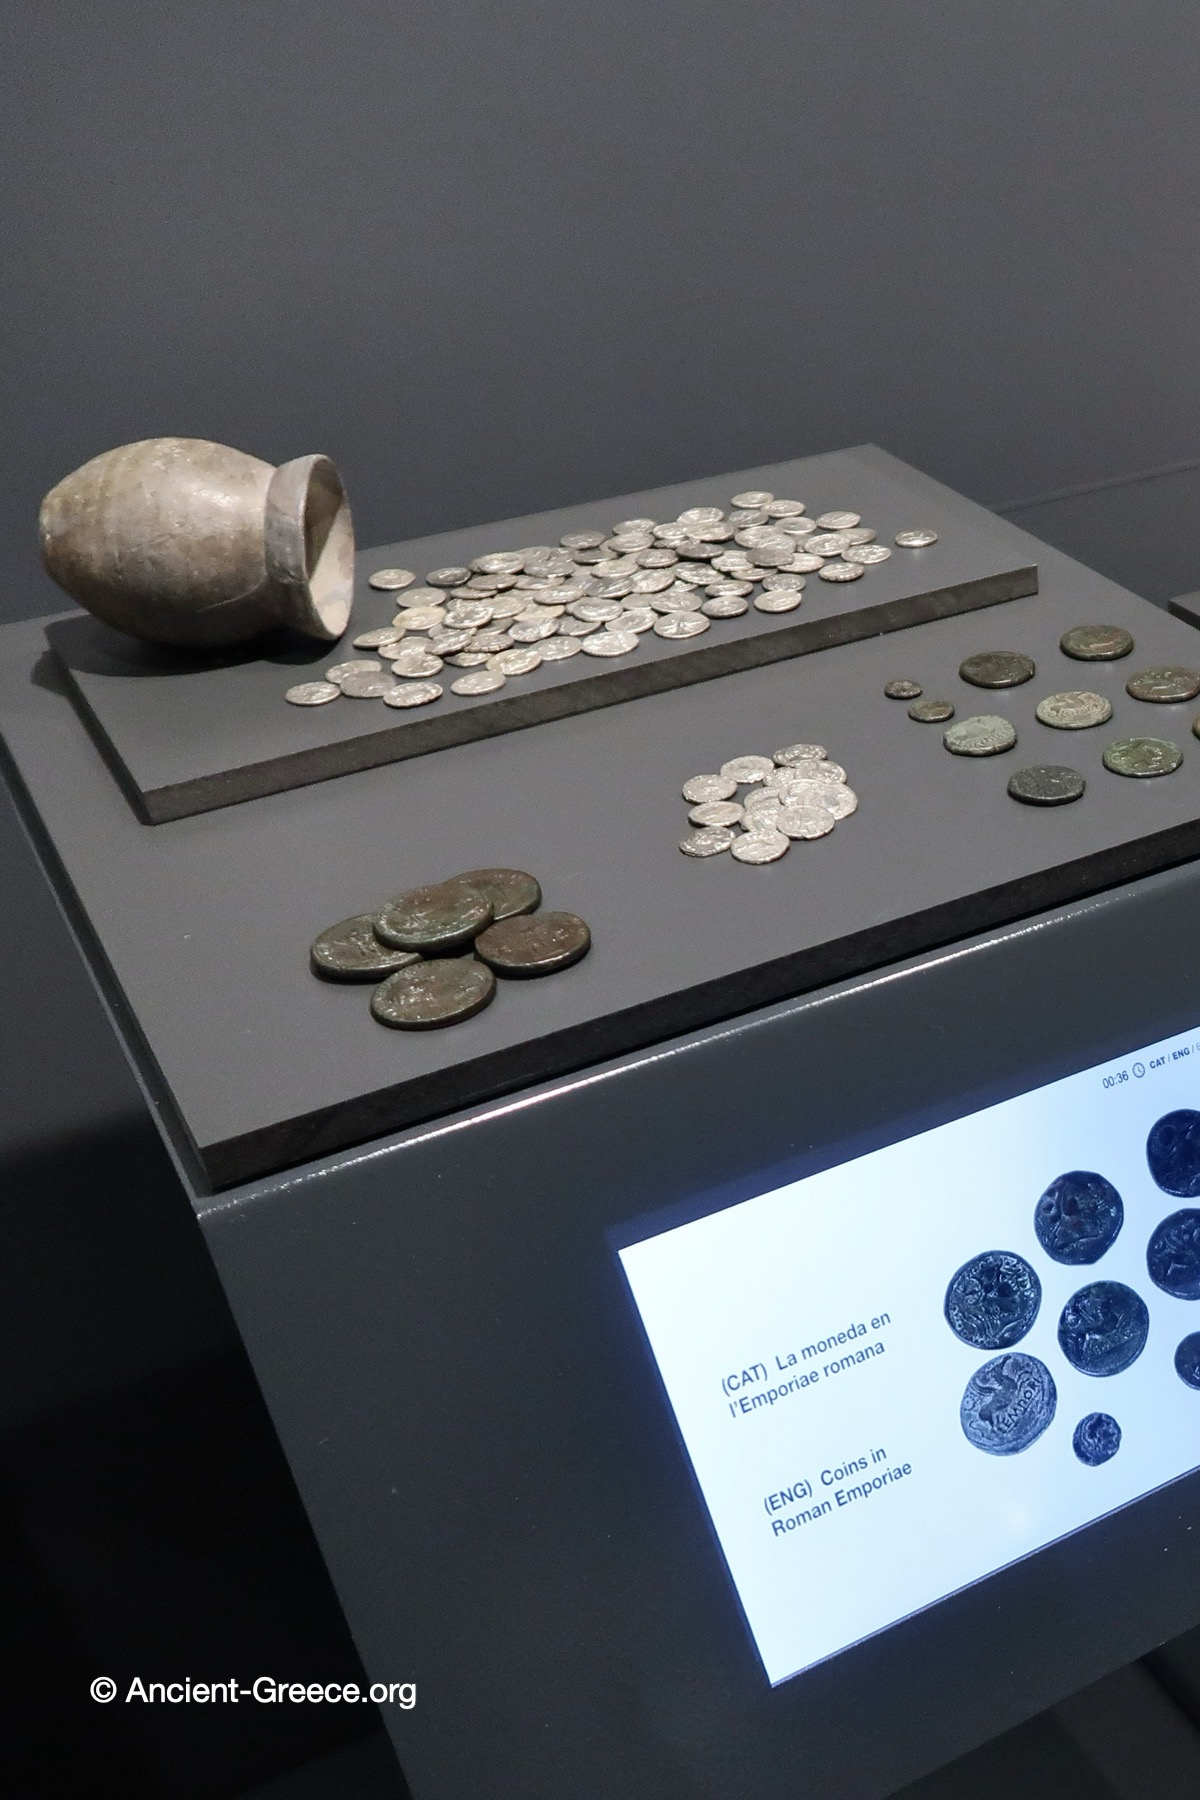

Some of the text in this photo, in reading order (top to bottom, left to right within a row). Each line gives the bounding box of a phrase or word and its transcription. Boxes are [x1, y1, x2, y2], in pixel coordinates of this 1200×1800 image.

[1102, 1070, 1129, 1089] 00:36
[1149, 1056, 1166, 1069] CAT
[1172, 1047, 1190, 1060] ENG
[721, 1313, 892, 1397] (CAT) La moneda en
[728, 1342, 886, 1419] l’Emporiae romana
[764, 1448, 887, 1516] (ENG) Coins in
[771, 1463, 912, 1537] Roman Emporiae
